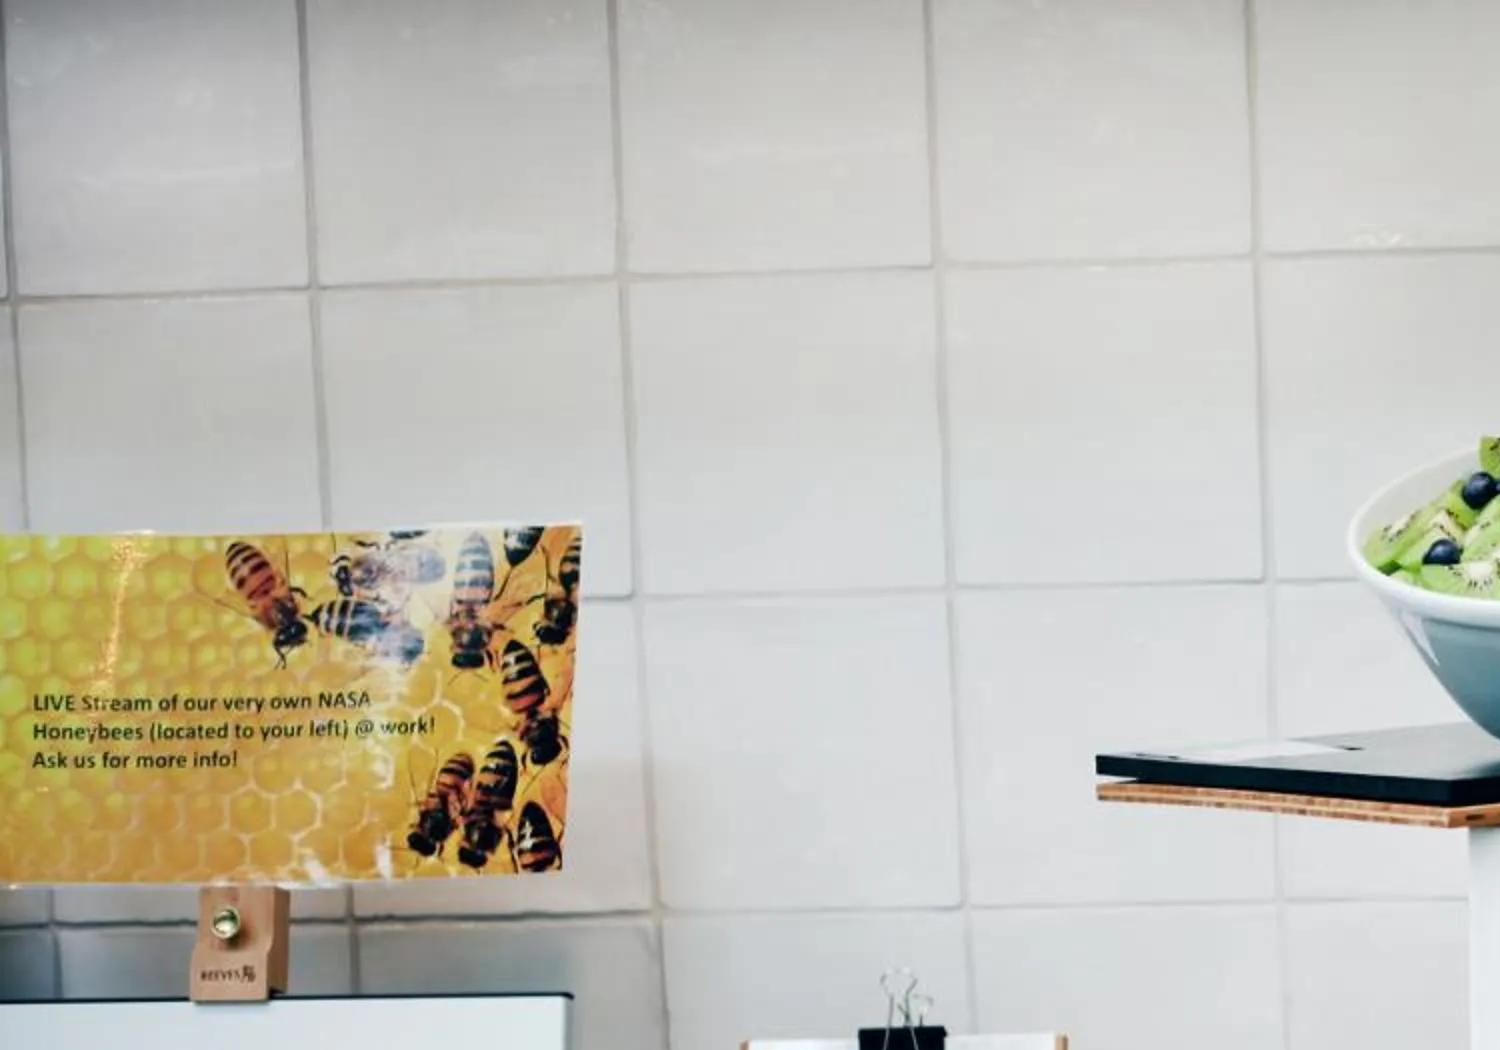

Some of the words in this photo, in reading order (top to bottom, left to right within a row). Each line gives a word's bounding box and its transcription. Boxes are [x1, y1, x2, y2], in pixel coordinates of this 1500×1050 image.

[33, 694, 75, 712] LIVE
[82, 694, 153, 712] Stream
[158, 693, 178, 712] of
[184, 698, 219, 712] our
[223, 694, 265, 713] very
[270, 694, 312, 710] own
[318, 691, 371, 709] NASA
[33, 723, 144, 744] Honeybees
[150, 721, 229, 743] (located
[234, 723, 254, 739] to
[260, 723, 304, 742] your
[309, 719, 349, 740] left)
[355, 719, 374, 738] @
[380, 715, 436, 735] work!
[32, 751, 68, 769] Ask
[73, 756, 96, 769] us
[102, 751, 131, 769] for
[136, 755, 188, 769] more
[193, 750, 238, 769] info!
